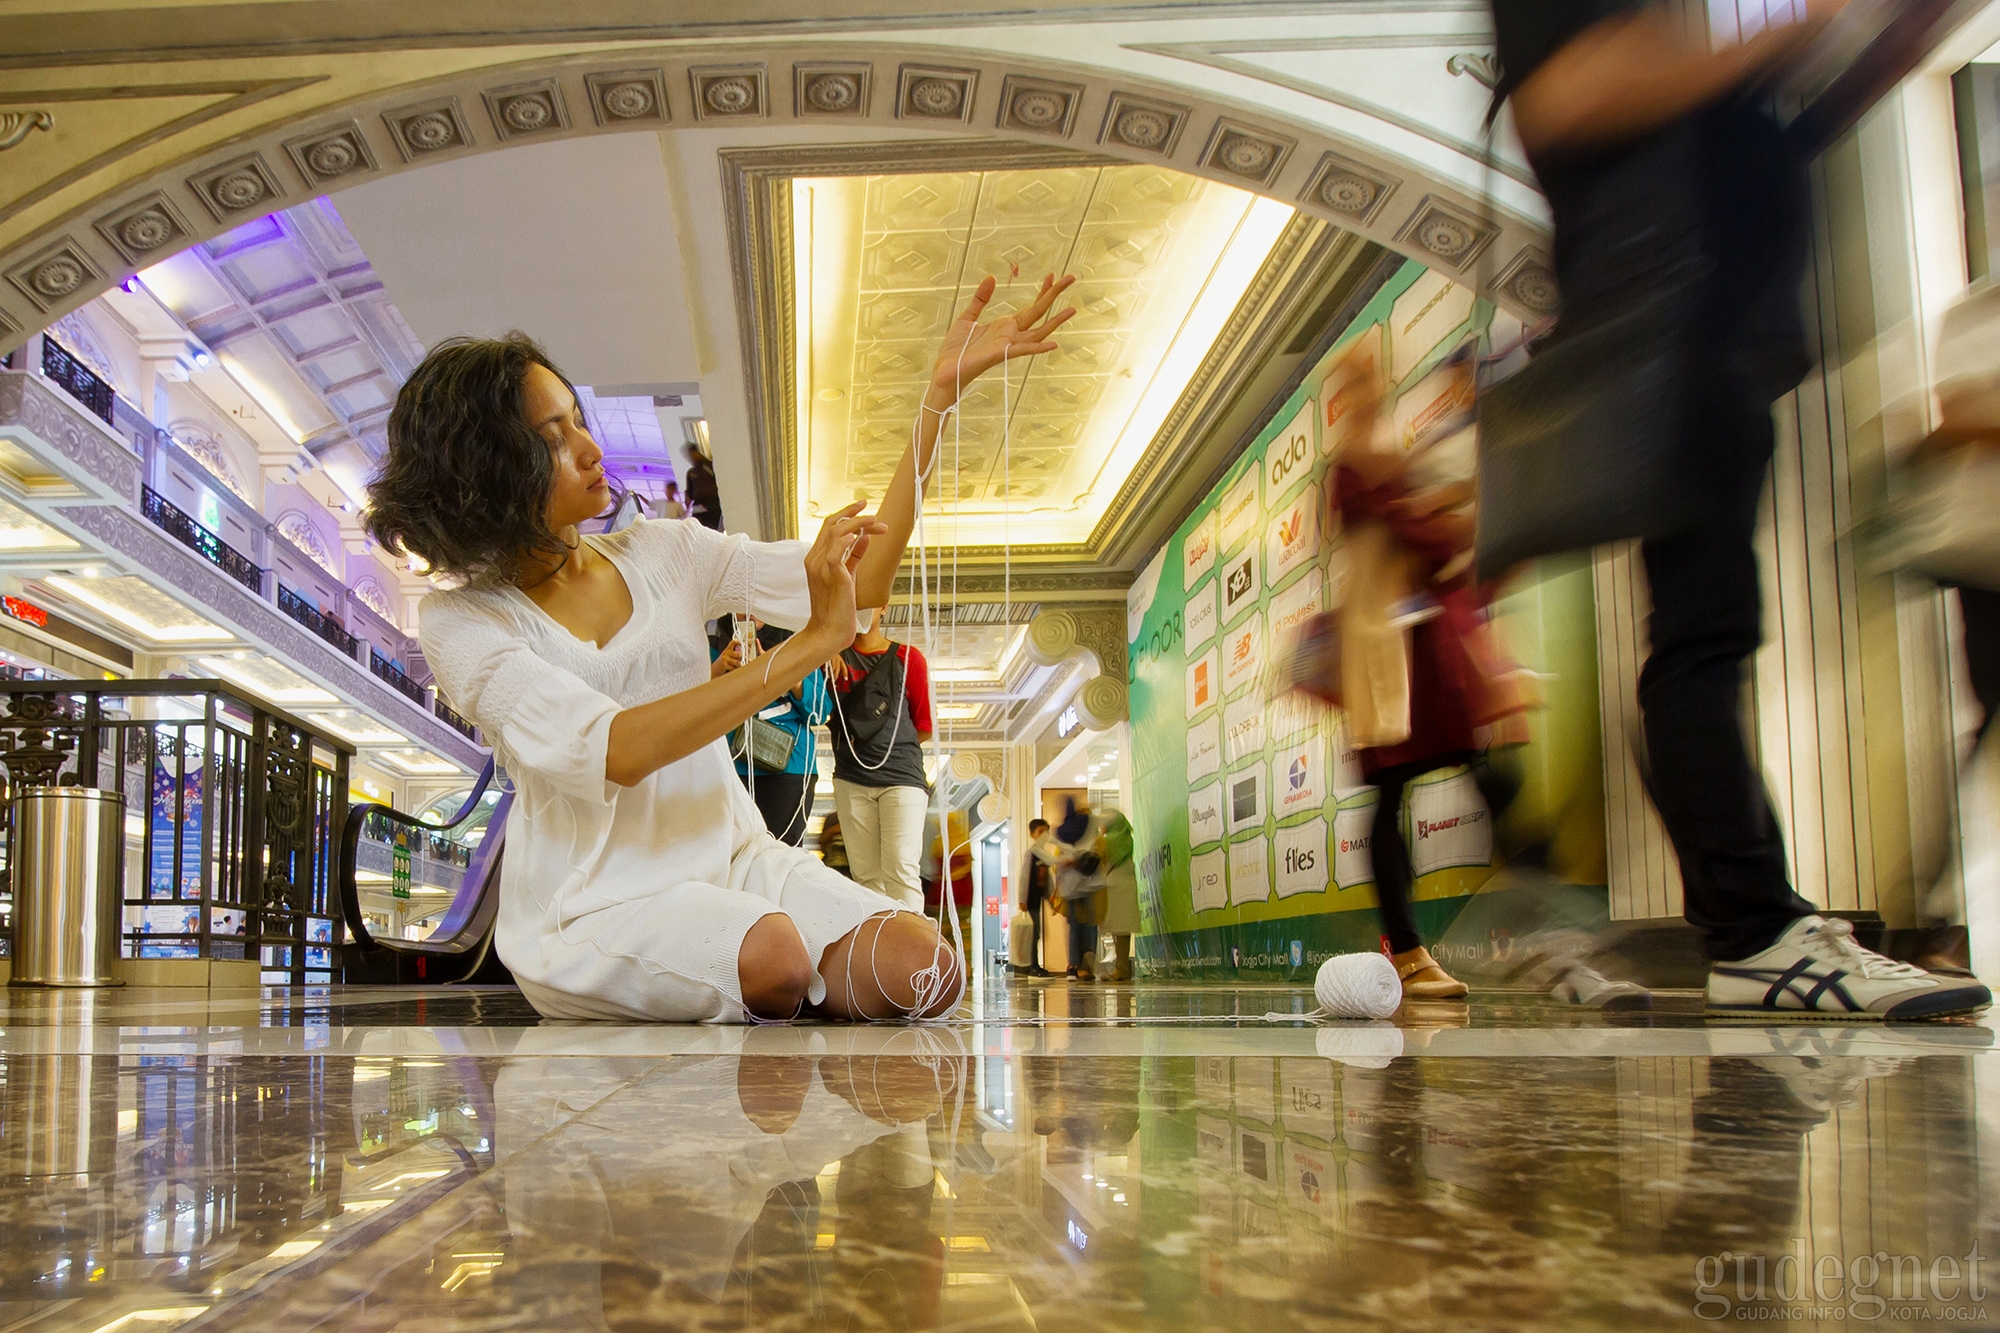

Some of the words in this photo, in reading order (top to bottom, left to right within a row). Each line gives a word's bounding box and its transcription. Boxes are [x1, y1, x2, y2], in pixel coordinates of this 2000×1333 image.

[1283, 601, 1316, 628] Payless
[1283, 788, 1312, 805] GRAMEDIA
[1428, 817, 1460, 833] PLANET
[1459, 811, 1485, 826] SURF
[1430, 943, 1453, 965] City
[1457, 942, 1484, 960] Mall
